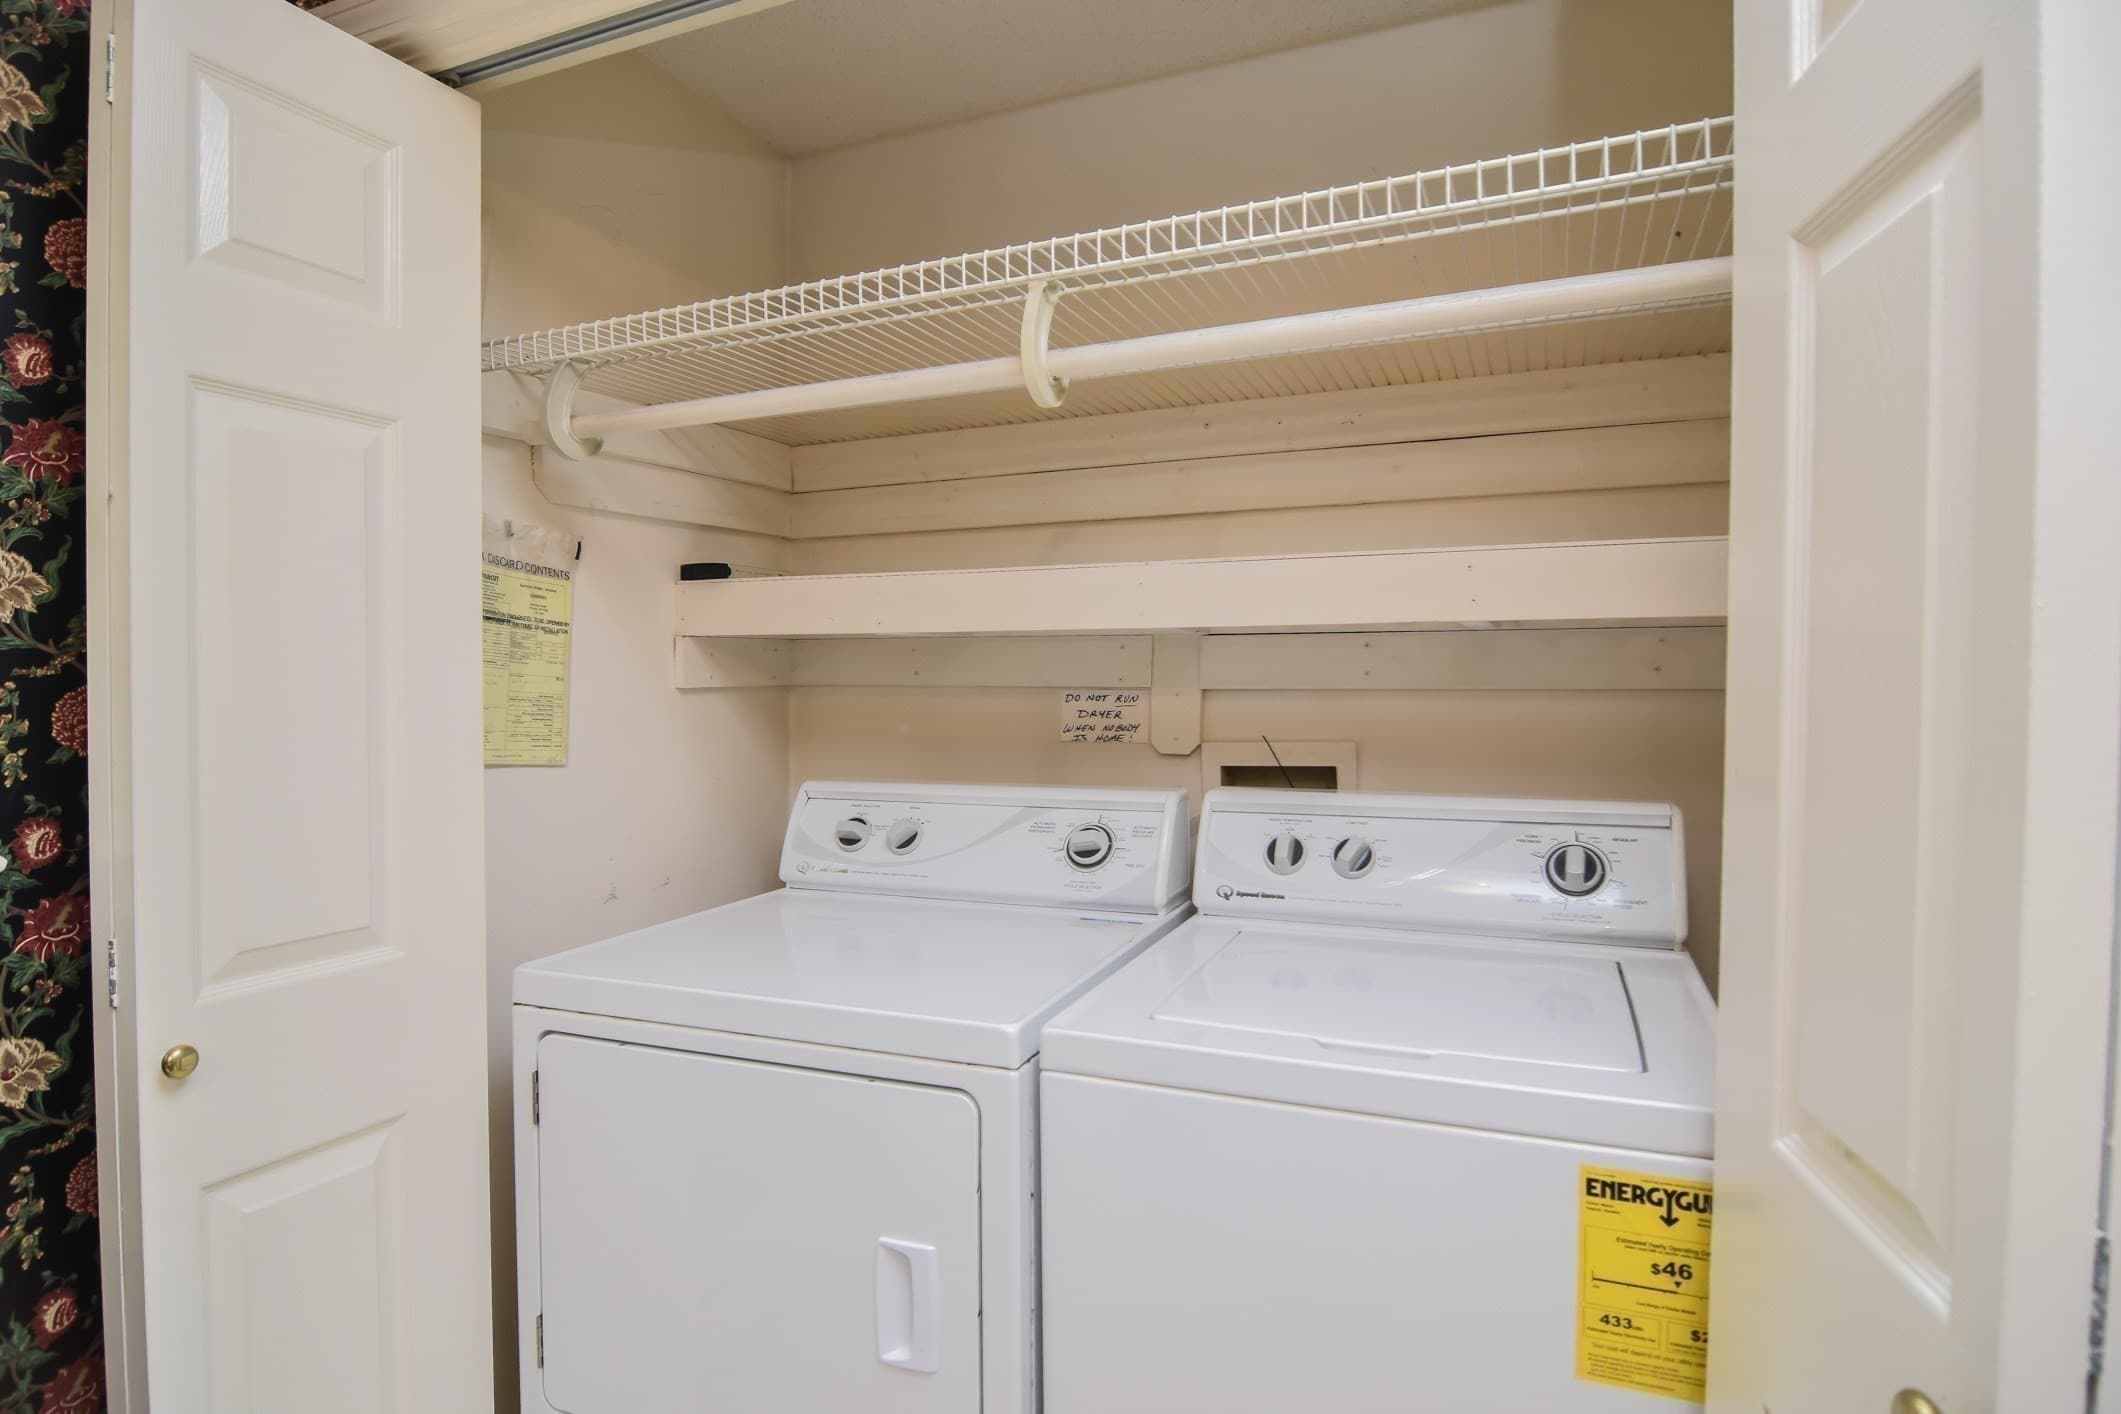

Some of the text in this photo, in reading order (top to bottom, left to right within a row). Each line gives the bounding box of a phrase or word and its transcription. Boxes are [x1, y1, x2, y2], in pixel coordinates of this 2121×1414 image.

[488, 553, 570, 581] DISCARD CONTENTS
[1065, 693, 1139, 704] DO NOT RUN
[1076, 709, 1123, 720] DRYER
[1062, 723, 1141, 734] WHEN NOBODY
[1072, 734, 1087, 742] IS
[1650, 1261, 1693, 1280] $46
[1600, 1314, 1632, 1330] 433
